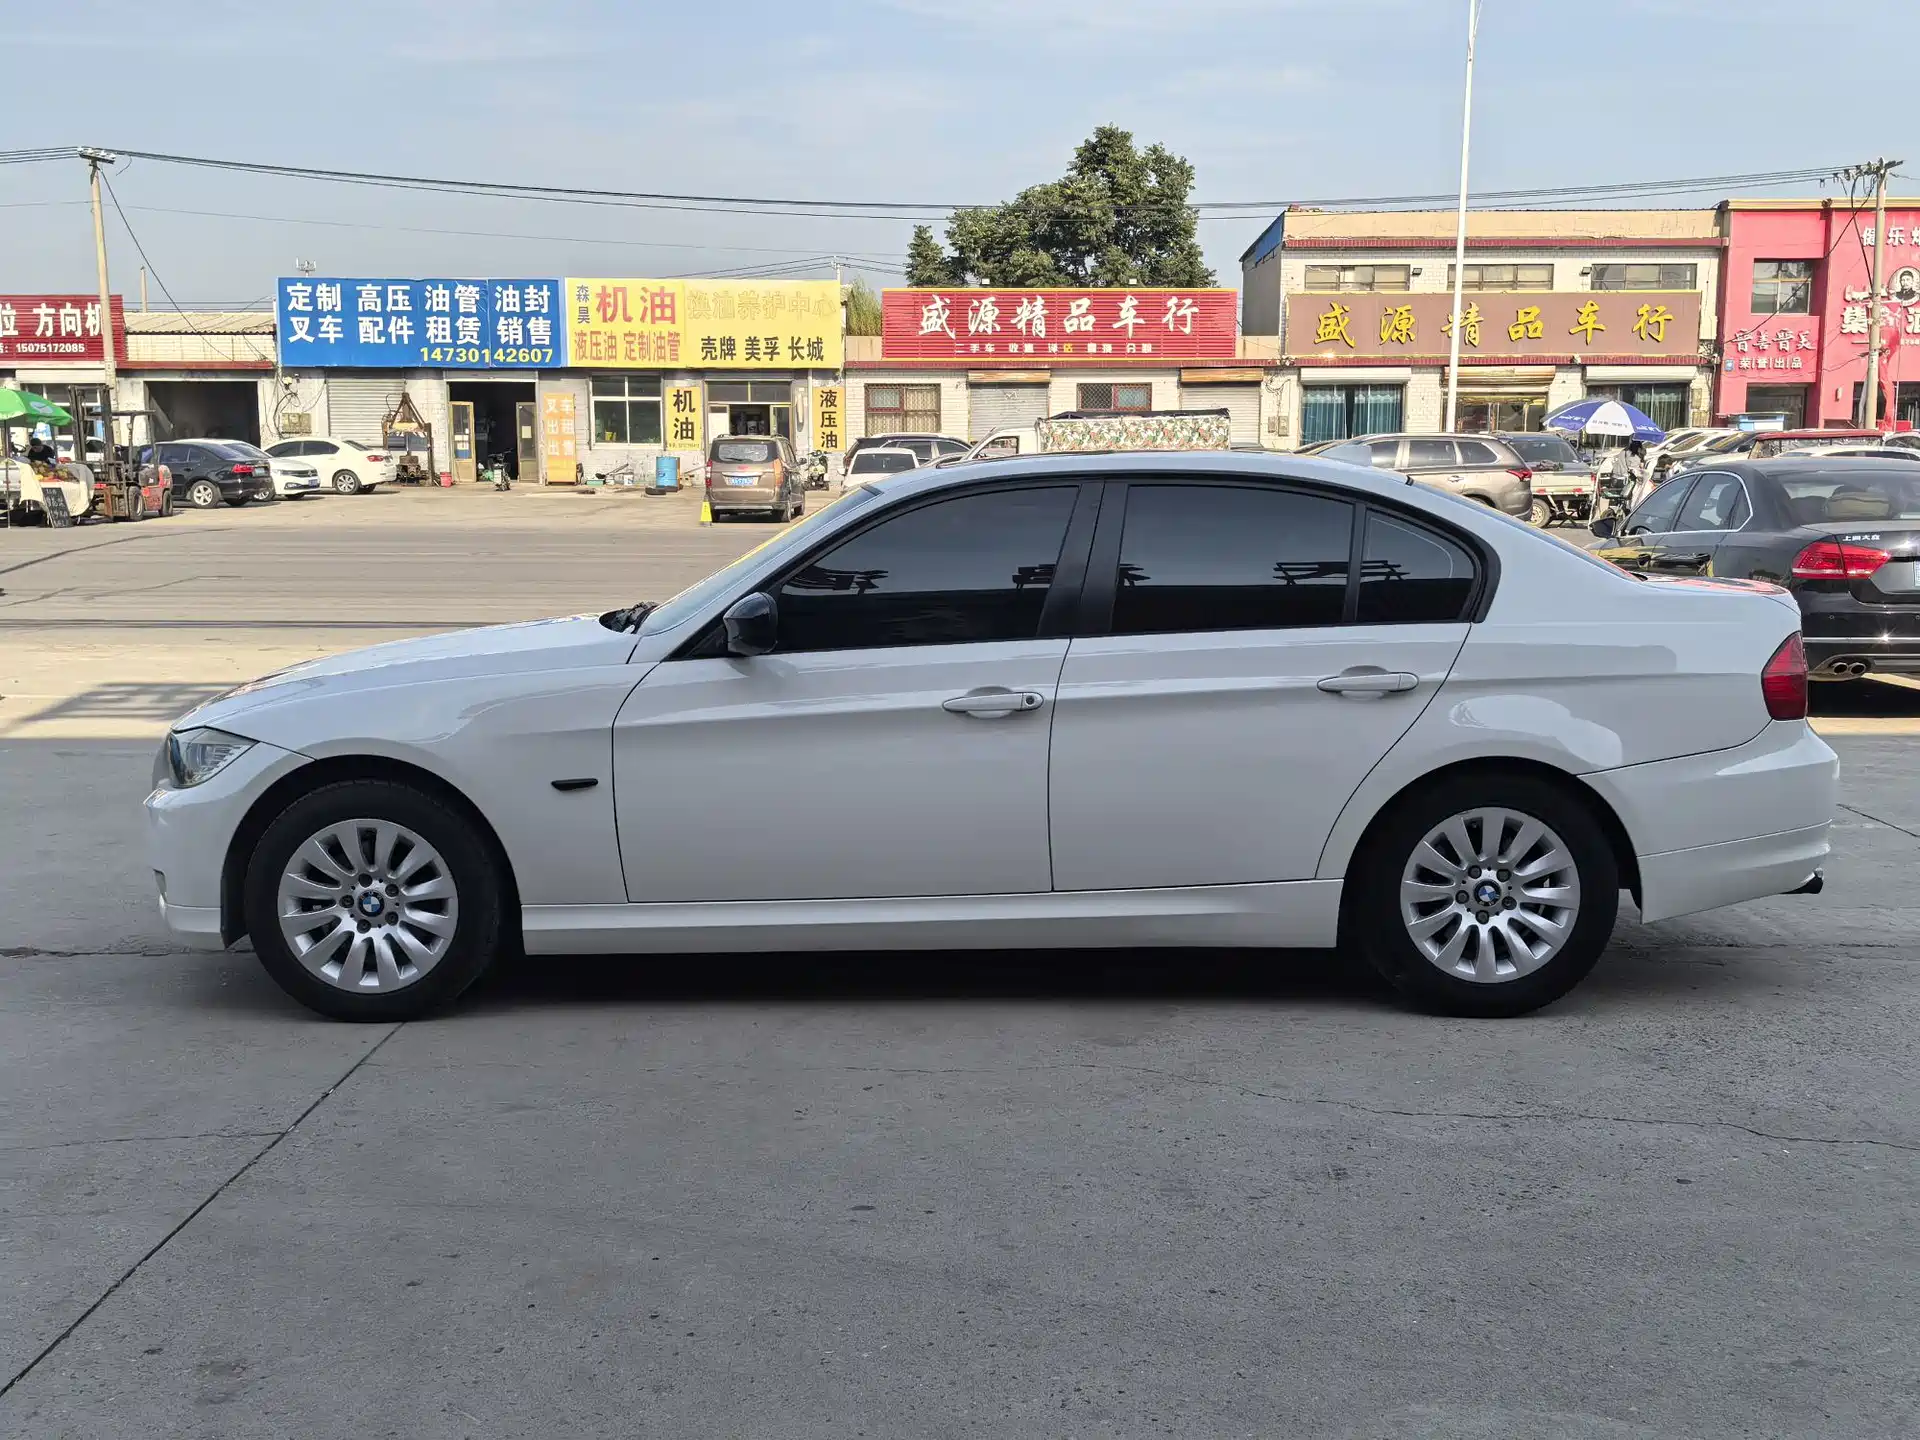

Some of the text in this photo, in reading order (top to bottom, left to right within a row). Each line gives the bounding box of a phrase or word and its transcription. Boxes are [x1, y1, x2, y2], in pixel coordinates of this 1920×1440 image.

[286, 283, 551, 314] 定制 高压 油管 油封
[596, 285, 676, 325] 机油
[288, 315, 552, 346] 叉车 配件 租赁 销售
[918, 294, 1200, 338] 盛源精品车行
[1313, 300, 1676, 348] 盛源精品车行
[16, 343, 85, 353] 15075172085
[420, 347, 553, 363] 14730142607
[574, 330, 681, 362] 液压油 定制油管
[701, 336, 824, 362] 壳牌 美孚 长城
[673, 389, 696, 441] 机油
[820, 389, 838, 449] 液压油
